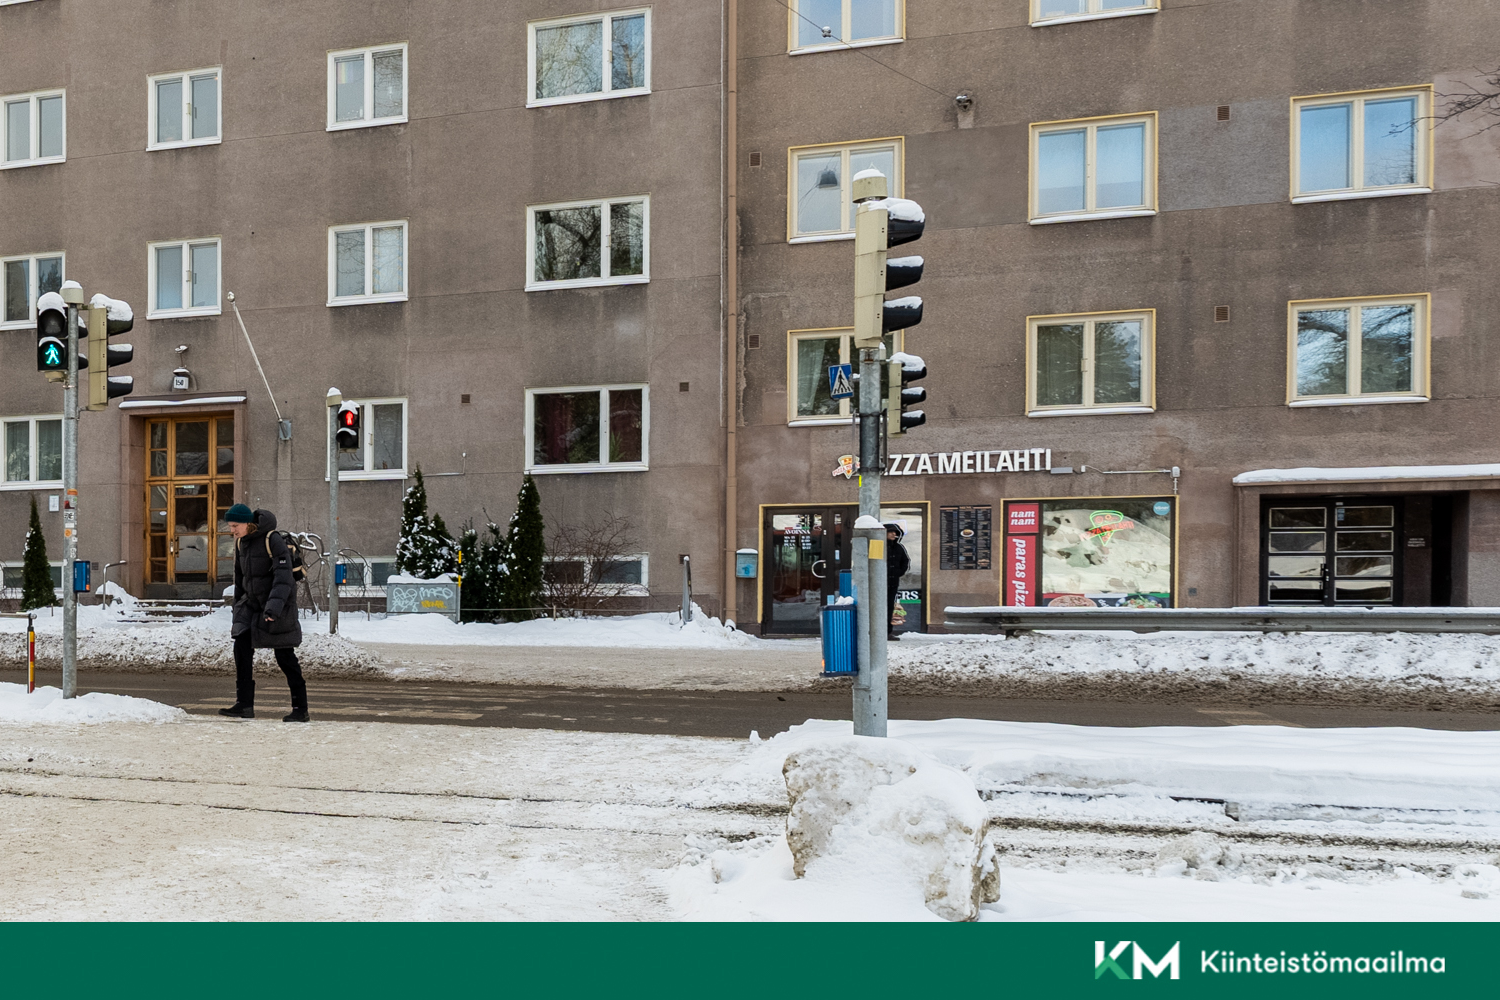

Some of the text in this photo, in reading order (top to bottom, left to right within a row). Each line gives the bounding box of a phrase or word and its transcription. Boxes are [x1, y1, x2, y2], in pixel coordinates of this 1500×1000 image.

[884, 453, 933, 476] ZZA
[938, 448, 1051, 474] MEILAHTI
[1010, 510, 1036, 518] nam
[1010, 518, 1036, 526] nam
[1012, 538, 1026, 578] paras
